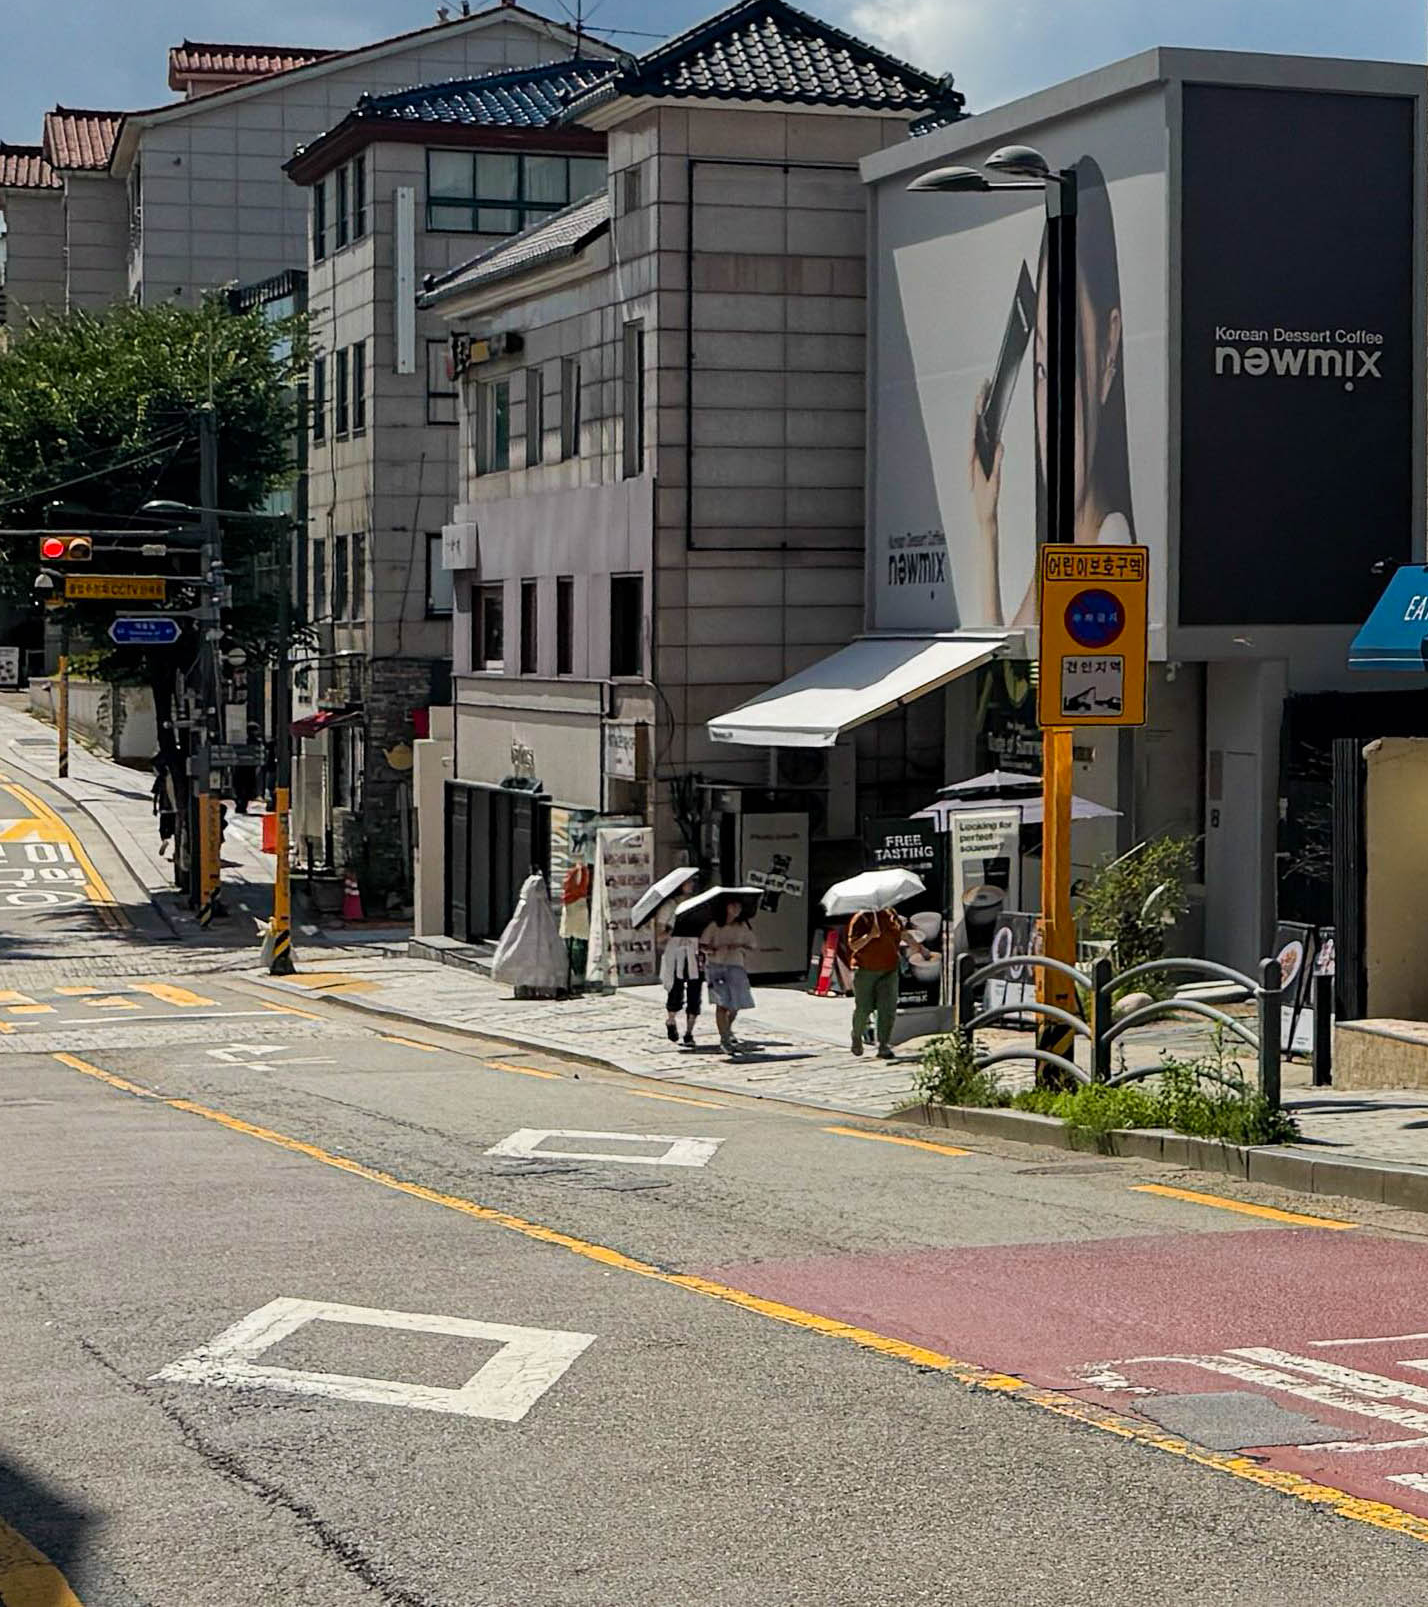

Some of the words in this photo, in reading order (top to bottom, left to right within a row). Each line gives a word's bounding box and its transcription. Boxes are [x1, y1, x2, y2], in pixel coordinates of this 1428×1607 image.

[1215, 326, 1268, 342] Korean
[1273, 327, 1330, 343] Dessert
[1335, 329, 1384, 345] Coffee
[1048, 556, 1141, 577] 어린이보호구역
[885, 834, 922, 848] FREE
[874, 845, 934, 861] TASTING
